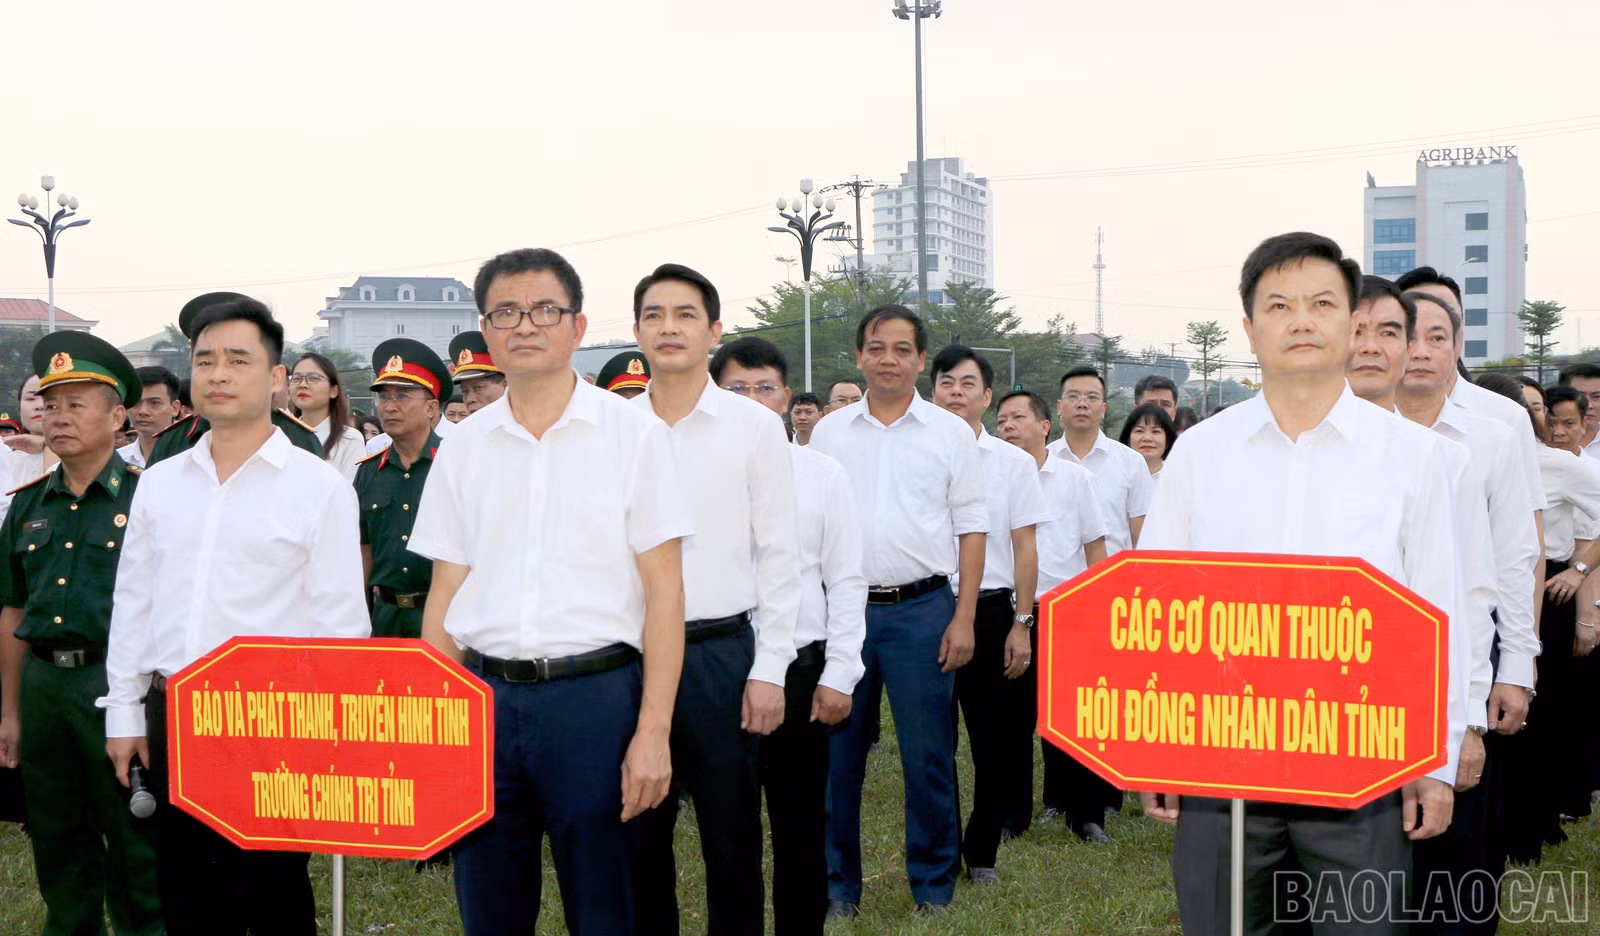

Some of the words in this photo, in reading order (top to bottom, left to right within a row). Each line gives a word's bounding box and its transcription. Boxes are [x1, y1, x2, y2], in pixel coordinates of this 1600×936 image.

[1418, 145, 1517, 161] AGRIBANK
[1111, 586, 1161, 652] CÁC
[1168, 595, 1204, 654] CƠ
[1209, 600, 1280, 662] QUAN
[1286, 596, 1372, 674] THUỘC
[192, 680, 223, 736] BÁO
[224, 681, 246, 737] VÀ
[247, 681, 285, 738] PHÁT
[287, 691, 338, 746] THANH,
[341, 679, 395, 743] TRUYỀN
[397, 686, 433, 744] HÌNH
[435, 681, 470, 746] TỈNH
[1076, 676, 1118, 751] HỘI
[1124, 672, 1195, 745] ĐỒNG
[1202, 684, 1276, 750] NHÂN
[1283, 688, 1338, 755] DÂN
[1344, 684, 1405, 760] TỈNH
[252, 761, 309, 820] TRƯỜNG
[312, 765, 354, 823] CHÍNH
[356, 776, 379, 835] TRỊ
[381, 761, 415, 826] TỈNH
